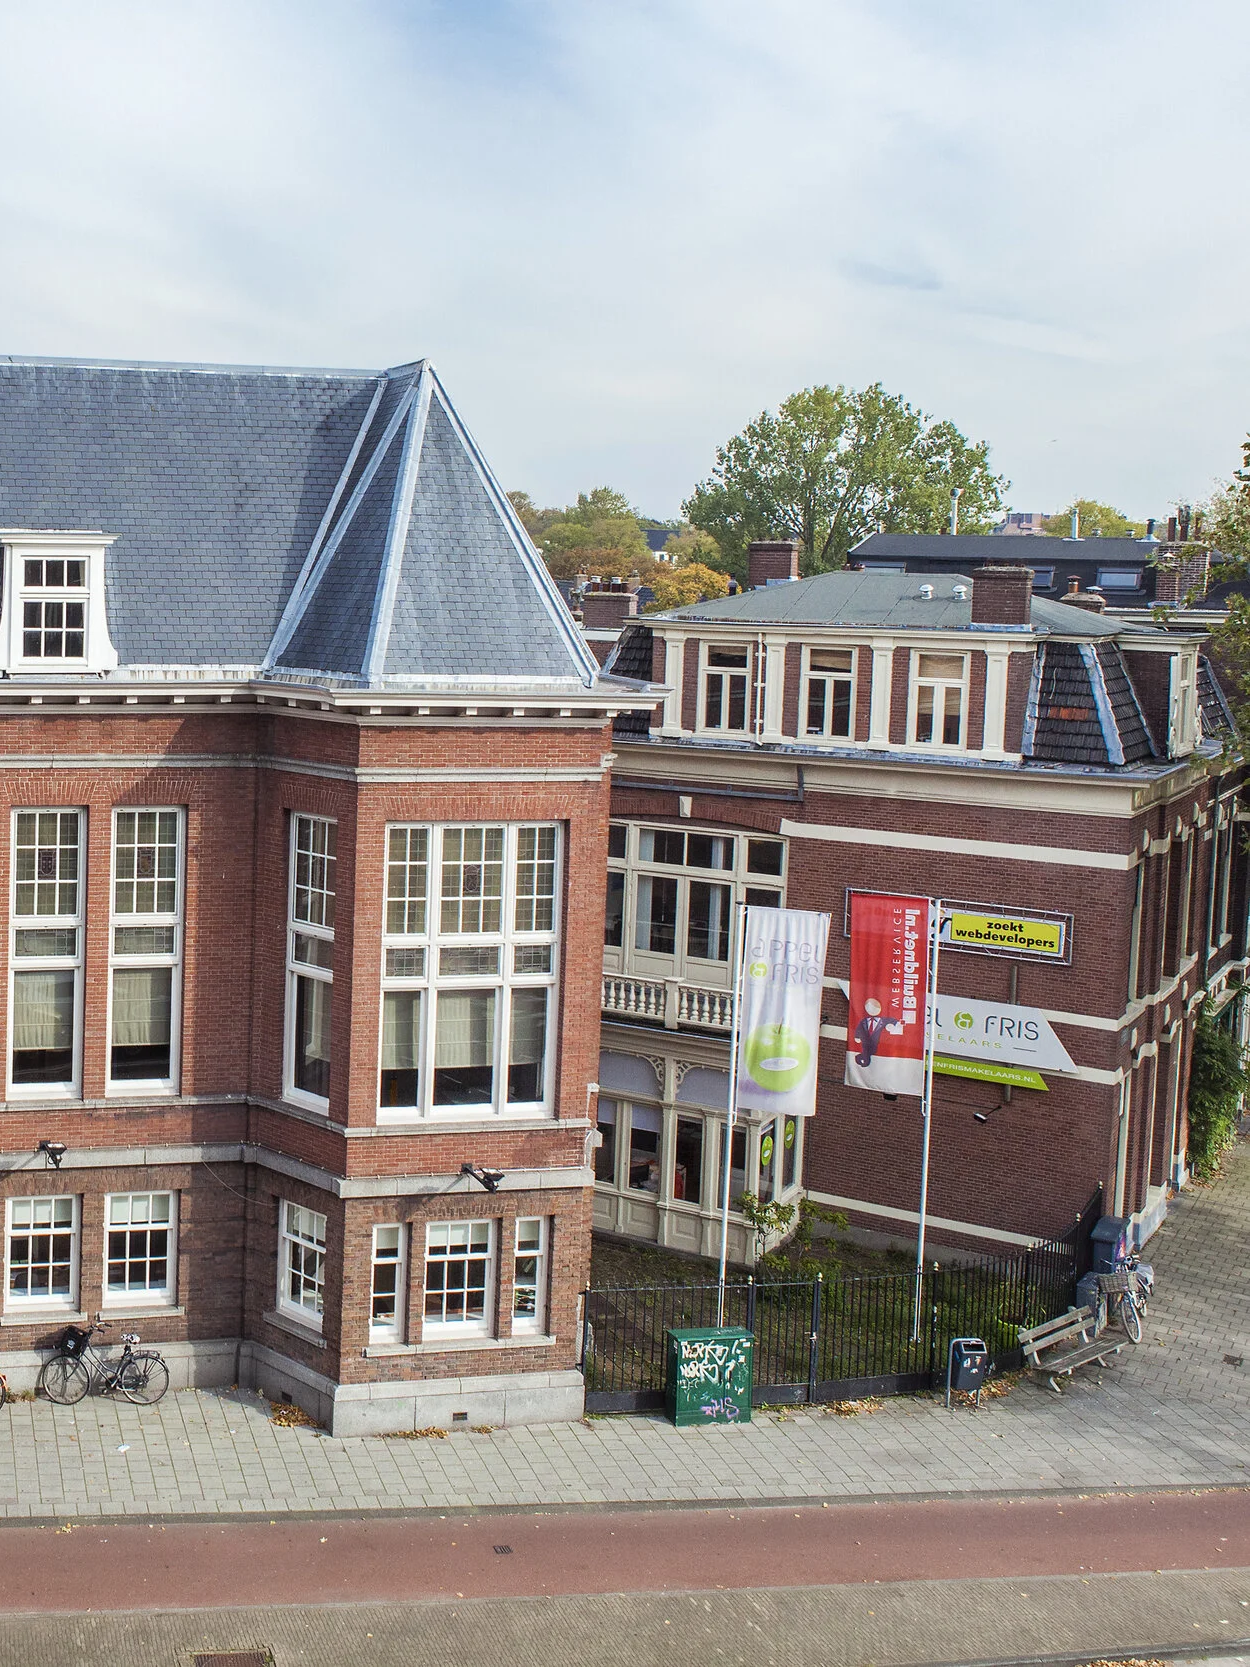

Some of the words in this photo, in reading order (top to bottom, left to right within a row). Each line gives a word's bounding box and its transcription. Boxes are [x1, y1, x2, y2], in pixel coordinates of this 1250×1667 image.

[986, 921, 1025, 933] zoekt
[955, 929, 1055, 948] webdevelopers
[771, 962, 819, 985] FRIS
[985, 1015, 1039, 1041] FRIS
[926, 1031, 1002, 1049] ELAARS
